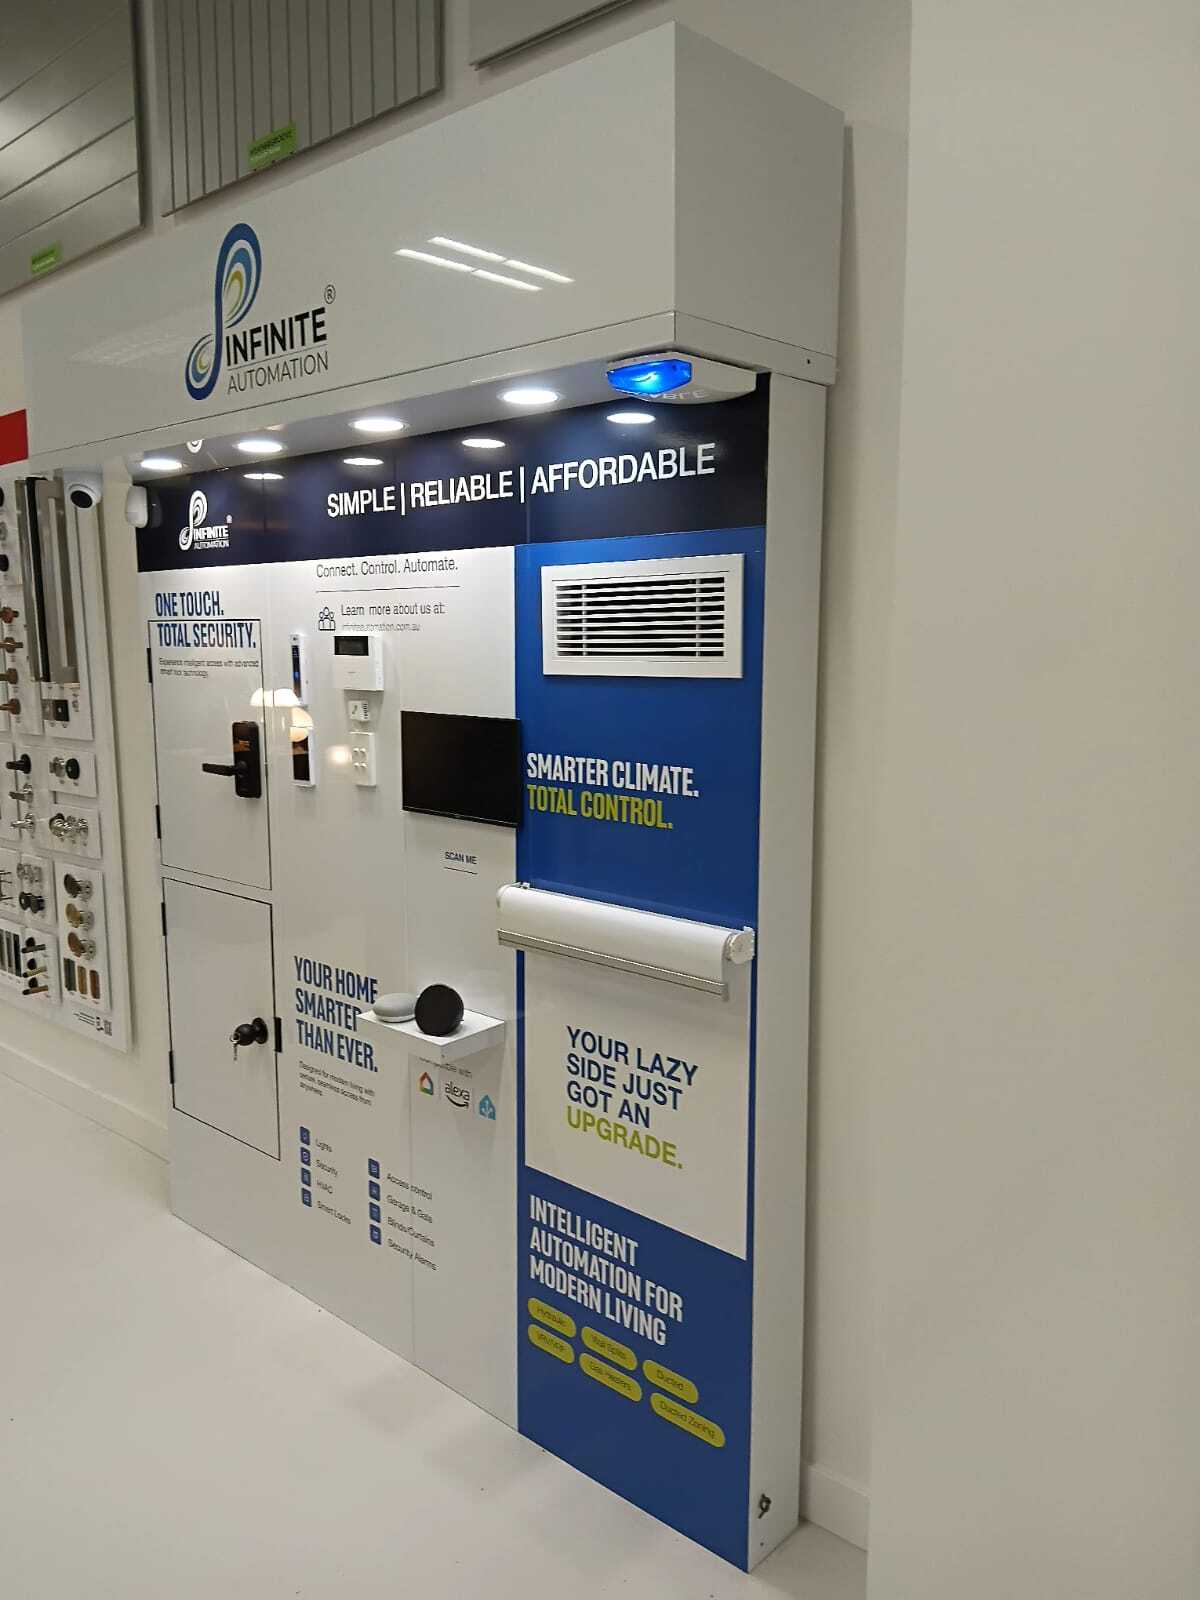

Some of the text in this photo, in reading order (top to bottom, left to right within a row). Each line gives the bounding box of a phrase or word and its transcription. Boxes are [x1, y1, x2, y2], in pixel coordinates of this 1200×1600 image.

[225, 307, 327, 366] INFINITE
[227, 351, 328, 395] AUTOMATION
[326, 486, 395, 518] SIMPLE
[410, 470, 513, 508] RELIABLE
[530, 442, 716, 495] AFFORDABLE
[193, 525, 230, 540] INFINITE
[316, 557, 458, 578] Connect. Control. Automate.
[155, 591, 224, 617] ONE TOUCH.
[340, 604, 365, 616] Learn
[369, 605, 390, 615] more
[393, 603, 418, 615] about
[420, 604, 431, 614] us
[157, 622, 257, 649] TOTAL SECURITY.
[526, 752, 700, 798] SMARTER CLIMATE.
[526, 784, 673, 830] TOTAL CONTROL.
[444, 851, 478, 865] SCAN ME
[294, 955, 378, 1004] YOUR HOME
[296, 1018, 334, 1056] THAN
[337, 1033, 378, 1073] EVER.
[566, 1025, 699, 1087] YOUR LAZY
[444, 1080, 470, 1101] alexa
[566, 1052, 683, 1110] SIDE JUST
[567, 1080, 650, 1129] GOT AN
[567, 1105, 683, 1169] UPGRADE.
[529, 1194, 639, 1267] INTELLIGENT
[529, 1226, 683, 1323] AUTOMATION FOR
[529, 1255, 667, 1346] MODERN LIVING
